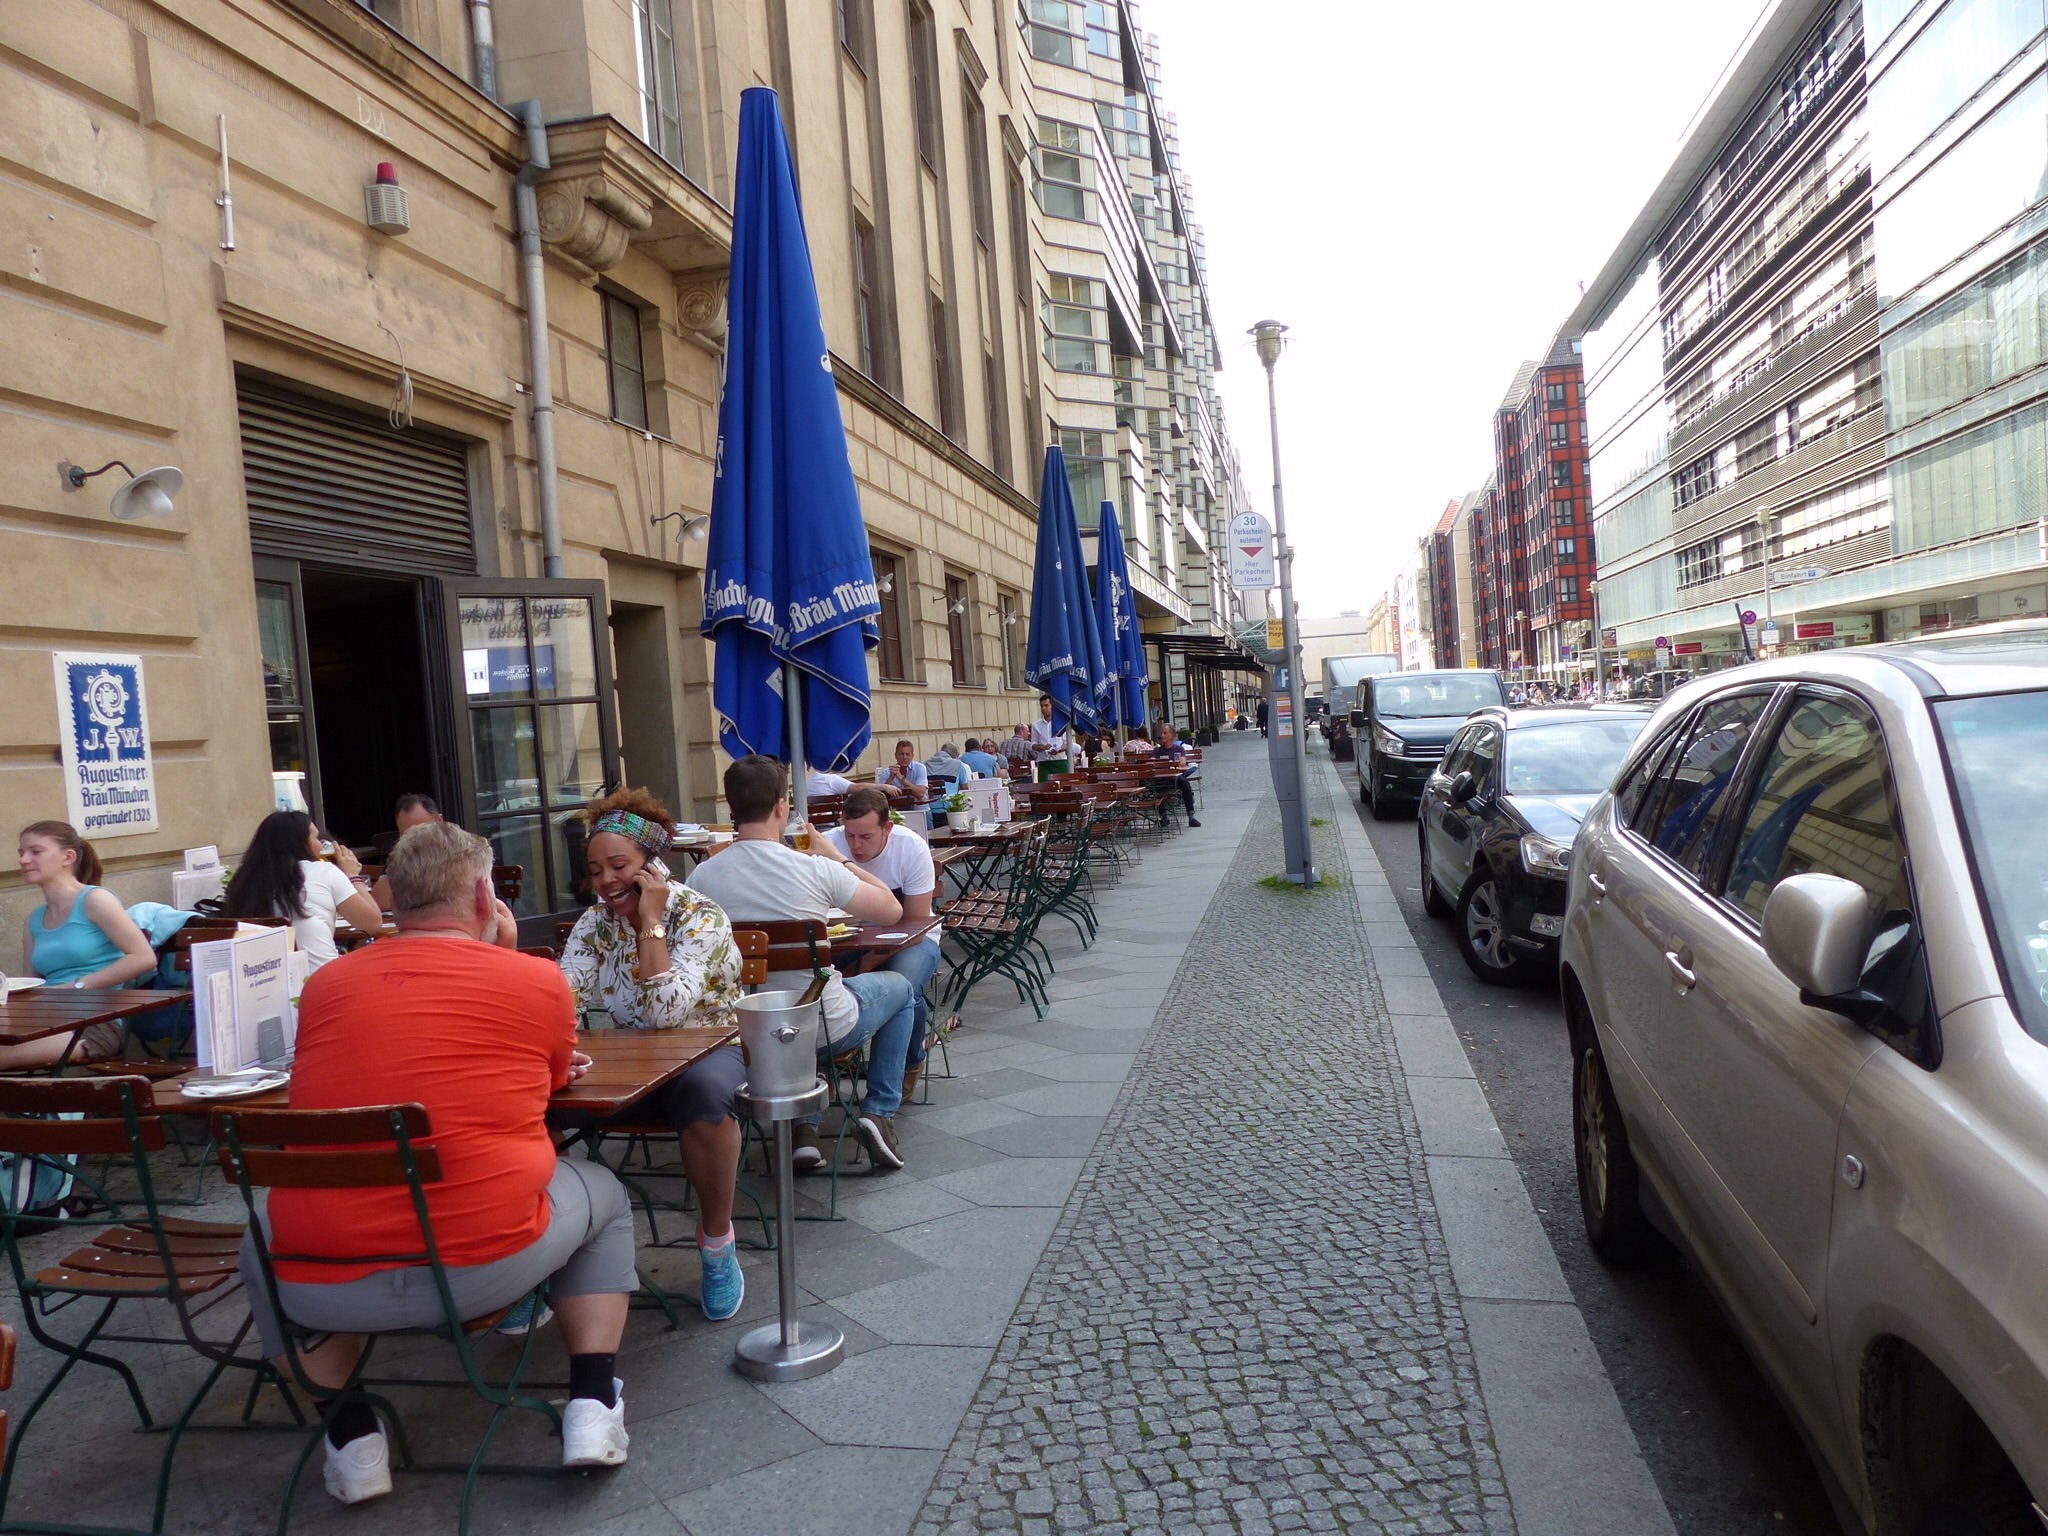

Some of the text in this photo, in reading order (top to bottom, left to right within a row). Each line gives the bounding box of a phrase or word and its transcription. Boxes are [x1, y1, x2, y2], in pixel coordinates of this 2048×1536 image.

[1243, 516, 1257, 526] 30
[1780, 571, 1807, 580] Einfahrt
[789, 596, 837, 633] Bräu
[81, 785, 150, 807] Bräu München
[84, 807, 151, 830] gegründet 1328
[242, 957, 282, 978] Augustiner
